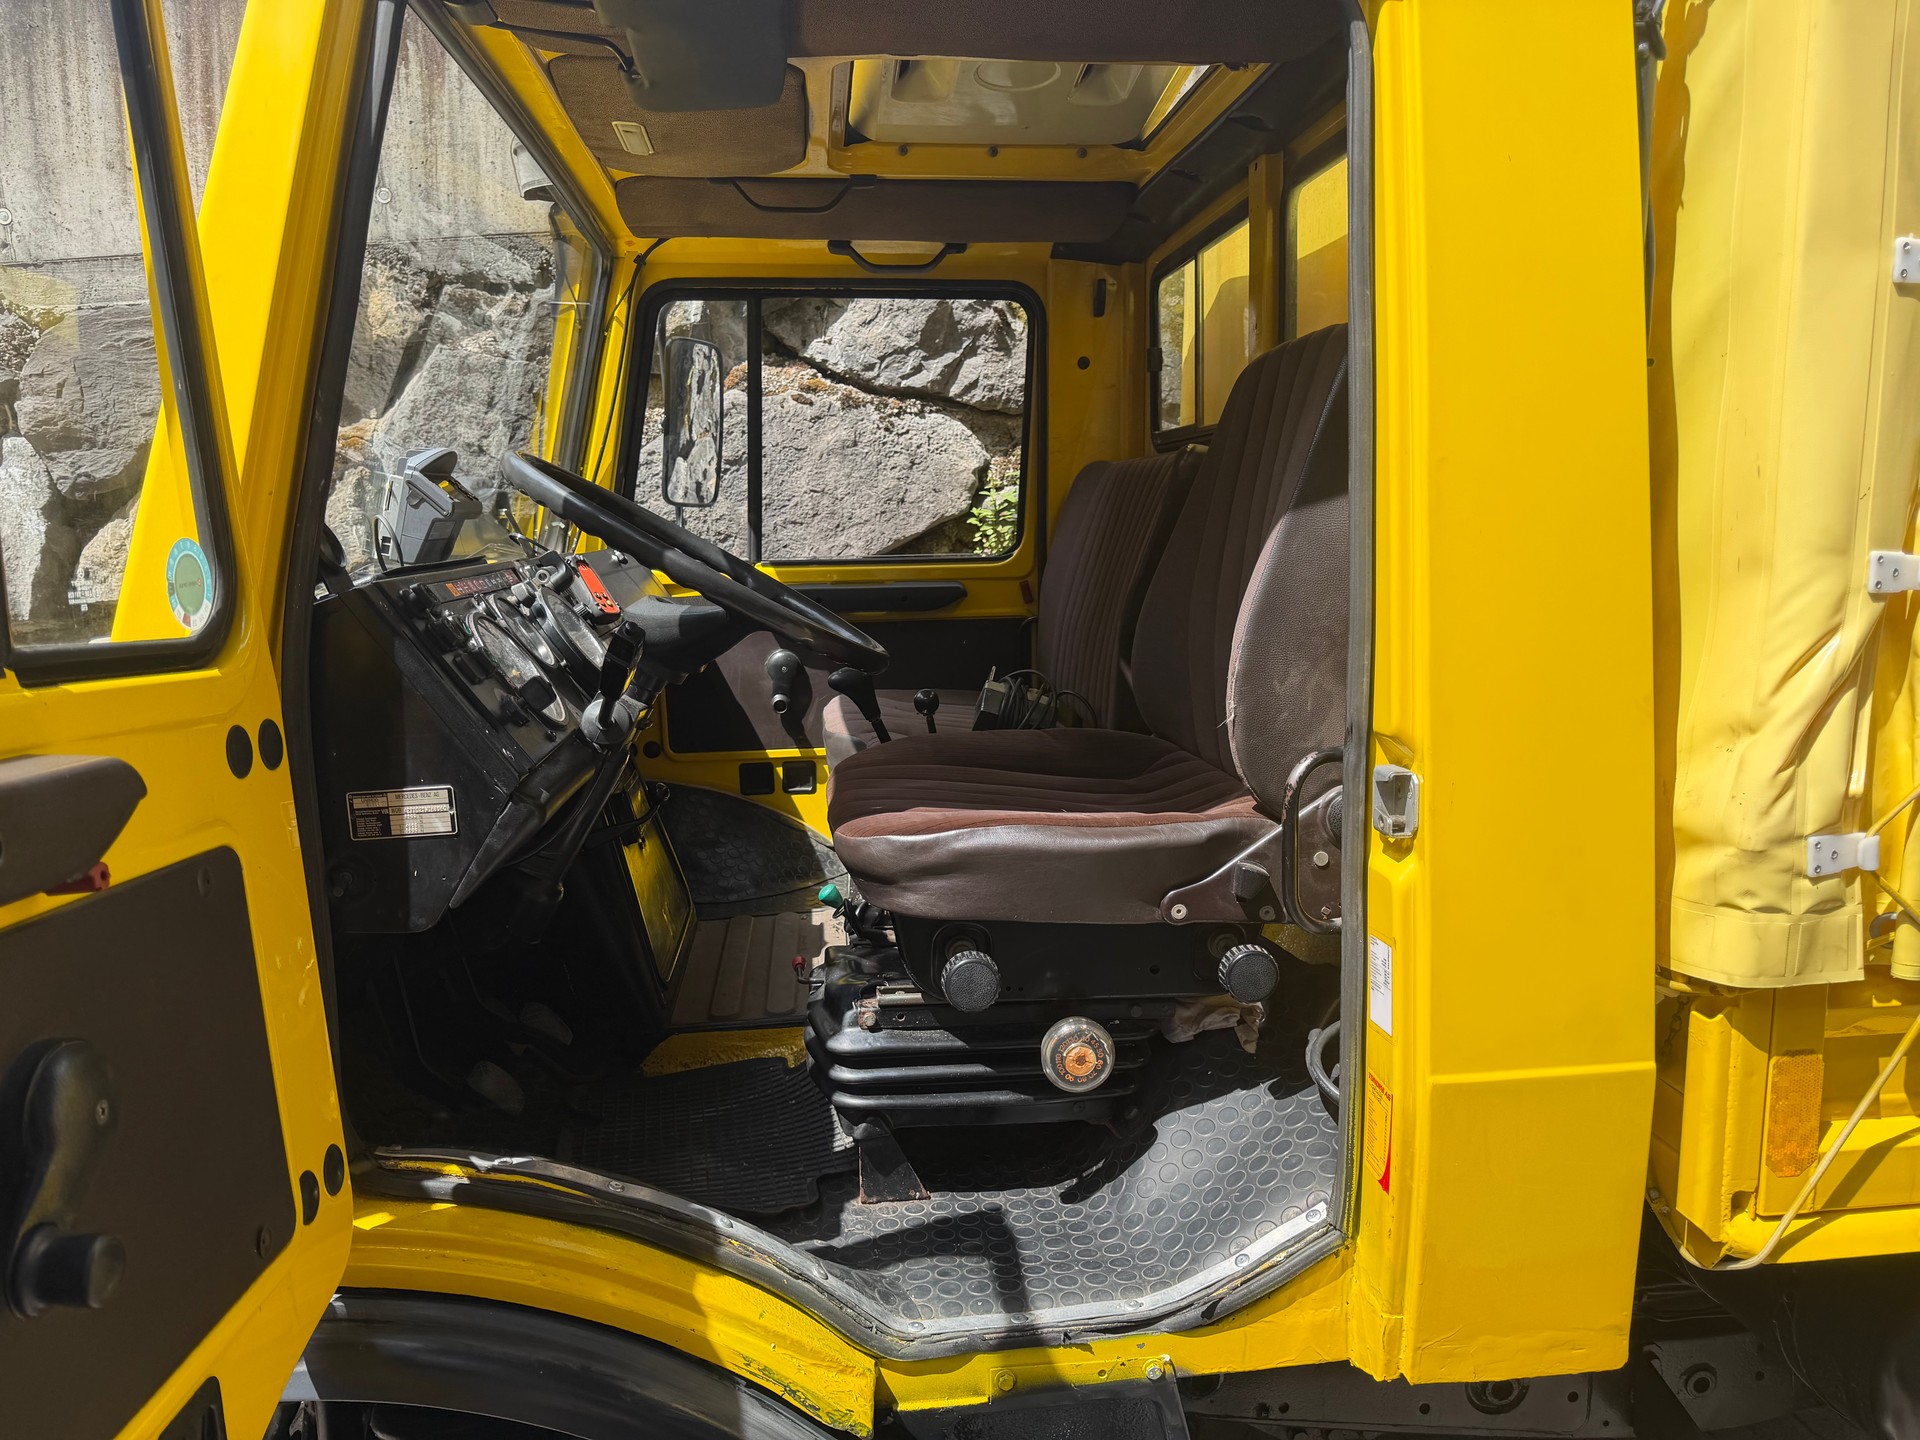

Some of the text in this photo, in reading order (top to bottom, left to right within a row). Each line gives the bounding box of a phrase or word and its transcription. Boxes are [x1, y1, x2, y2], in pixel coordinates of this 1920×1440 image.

[1091, 1040, 1099, 1048] 45
[1096, 1060, 1104, 1070] 60
[1065, 1073, 1075, 1082] 90
